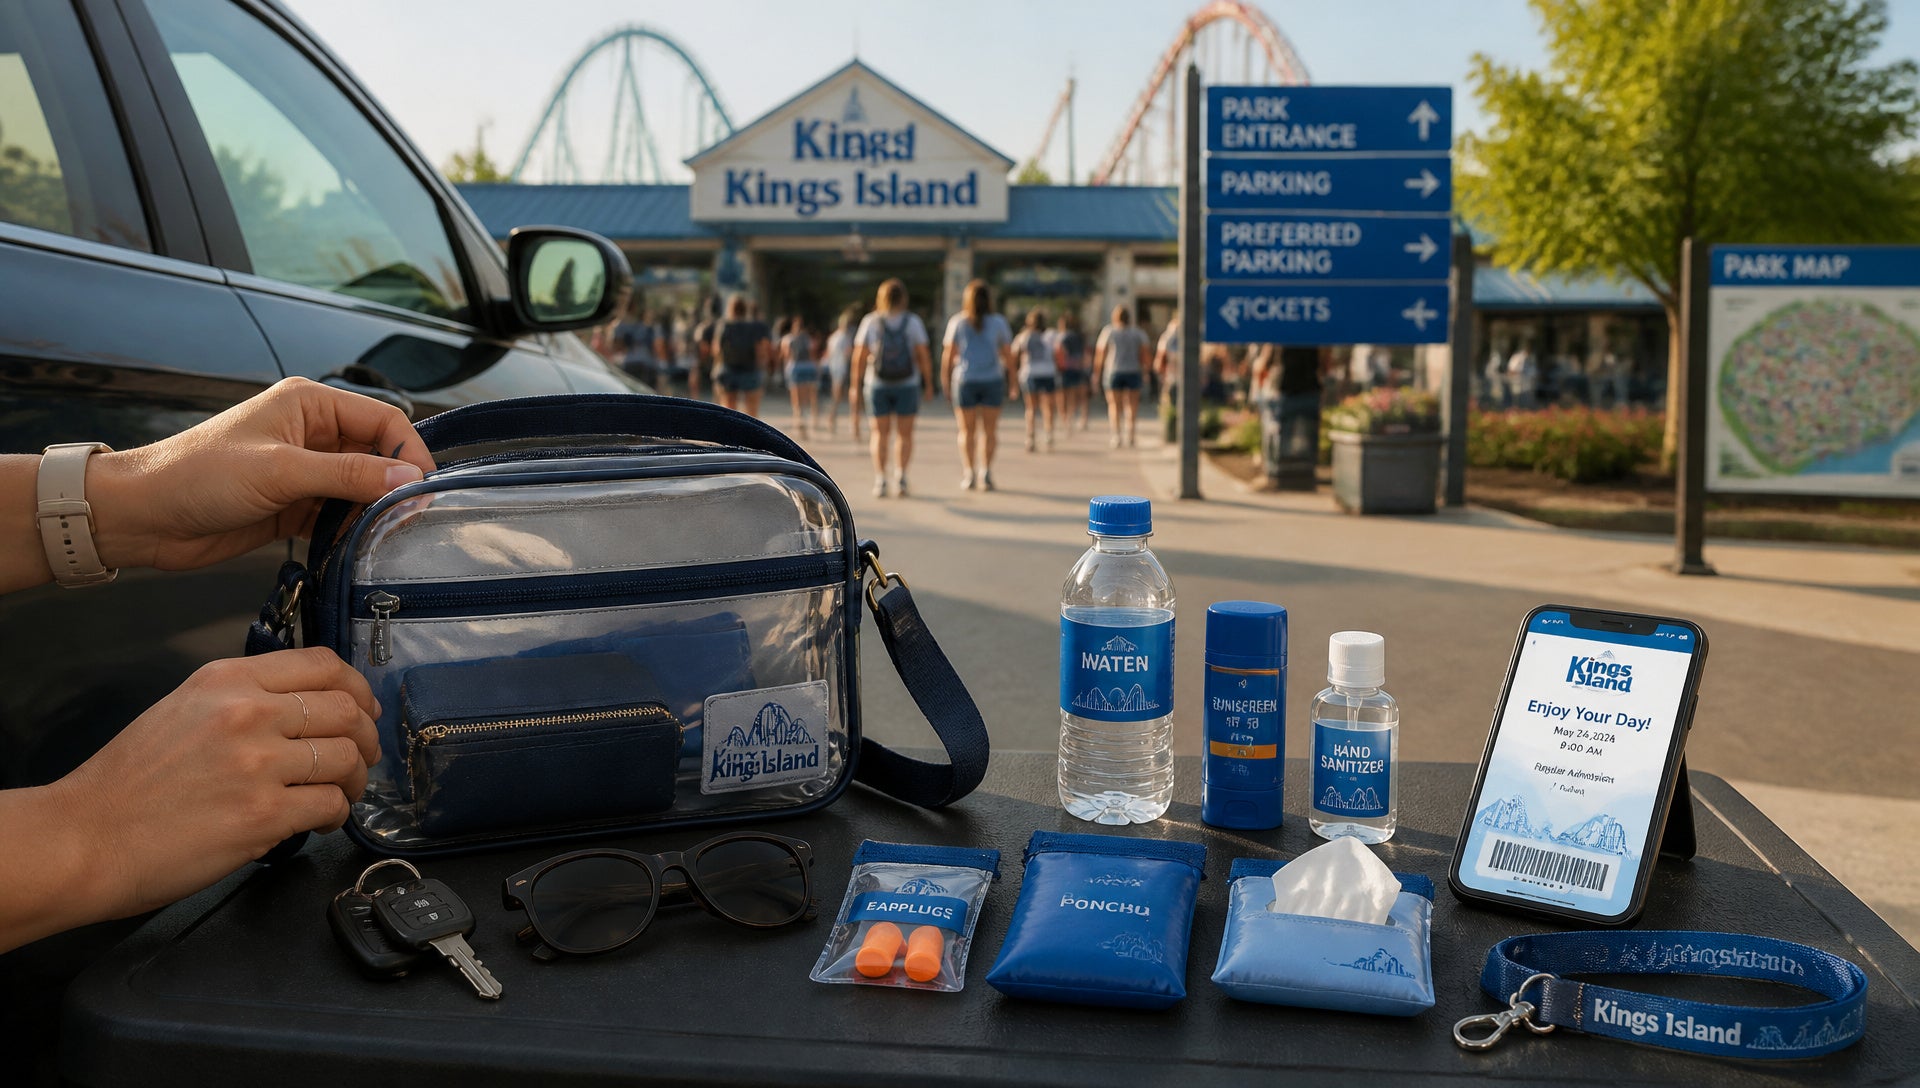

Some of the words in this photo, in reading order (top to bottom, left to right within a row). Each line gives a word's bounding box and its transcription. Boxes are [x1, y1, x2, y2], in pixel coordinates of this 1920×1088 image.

[1221, 96, 1290, 120] PARK
[1221, 123, 1357, 148] ENTRANCE
[725, 169, 840, 217] Kings
[855, 170, 979, 206] Island
[1221, 170, 1332, 195] PARKING
[1221, 222, 1362, 247] PREFERRED
[1221, 249, 1333, 274] PARKING
[1723, 253, 1789, 279] PARK
[1793, 254, 1851, 279] MAP
[1566, 655, 1633, 681] Kings
[1527, 699, 1571, 721] Enjoy
[1575, 706, 1612, 724] Your
[1615, 712, 1652, 732] Day!
[1553, 726, 1575, 738] May
[761, 744, 819, 774] Island
[1333, 743, 1371, 759] HAND
[1585, 745, 1603, 756] AM
[1593, 998, 1660, 1036] Kings
[1665, 1011, 1743, 1046] Island
